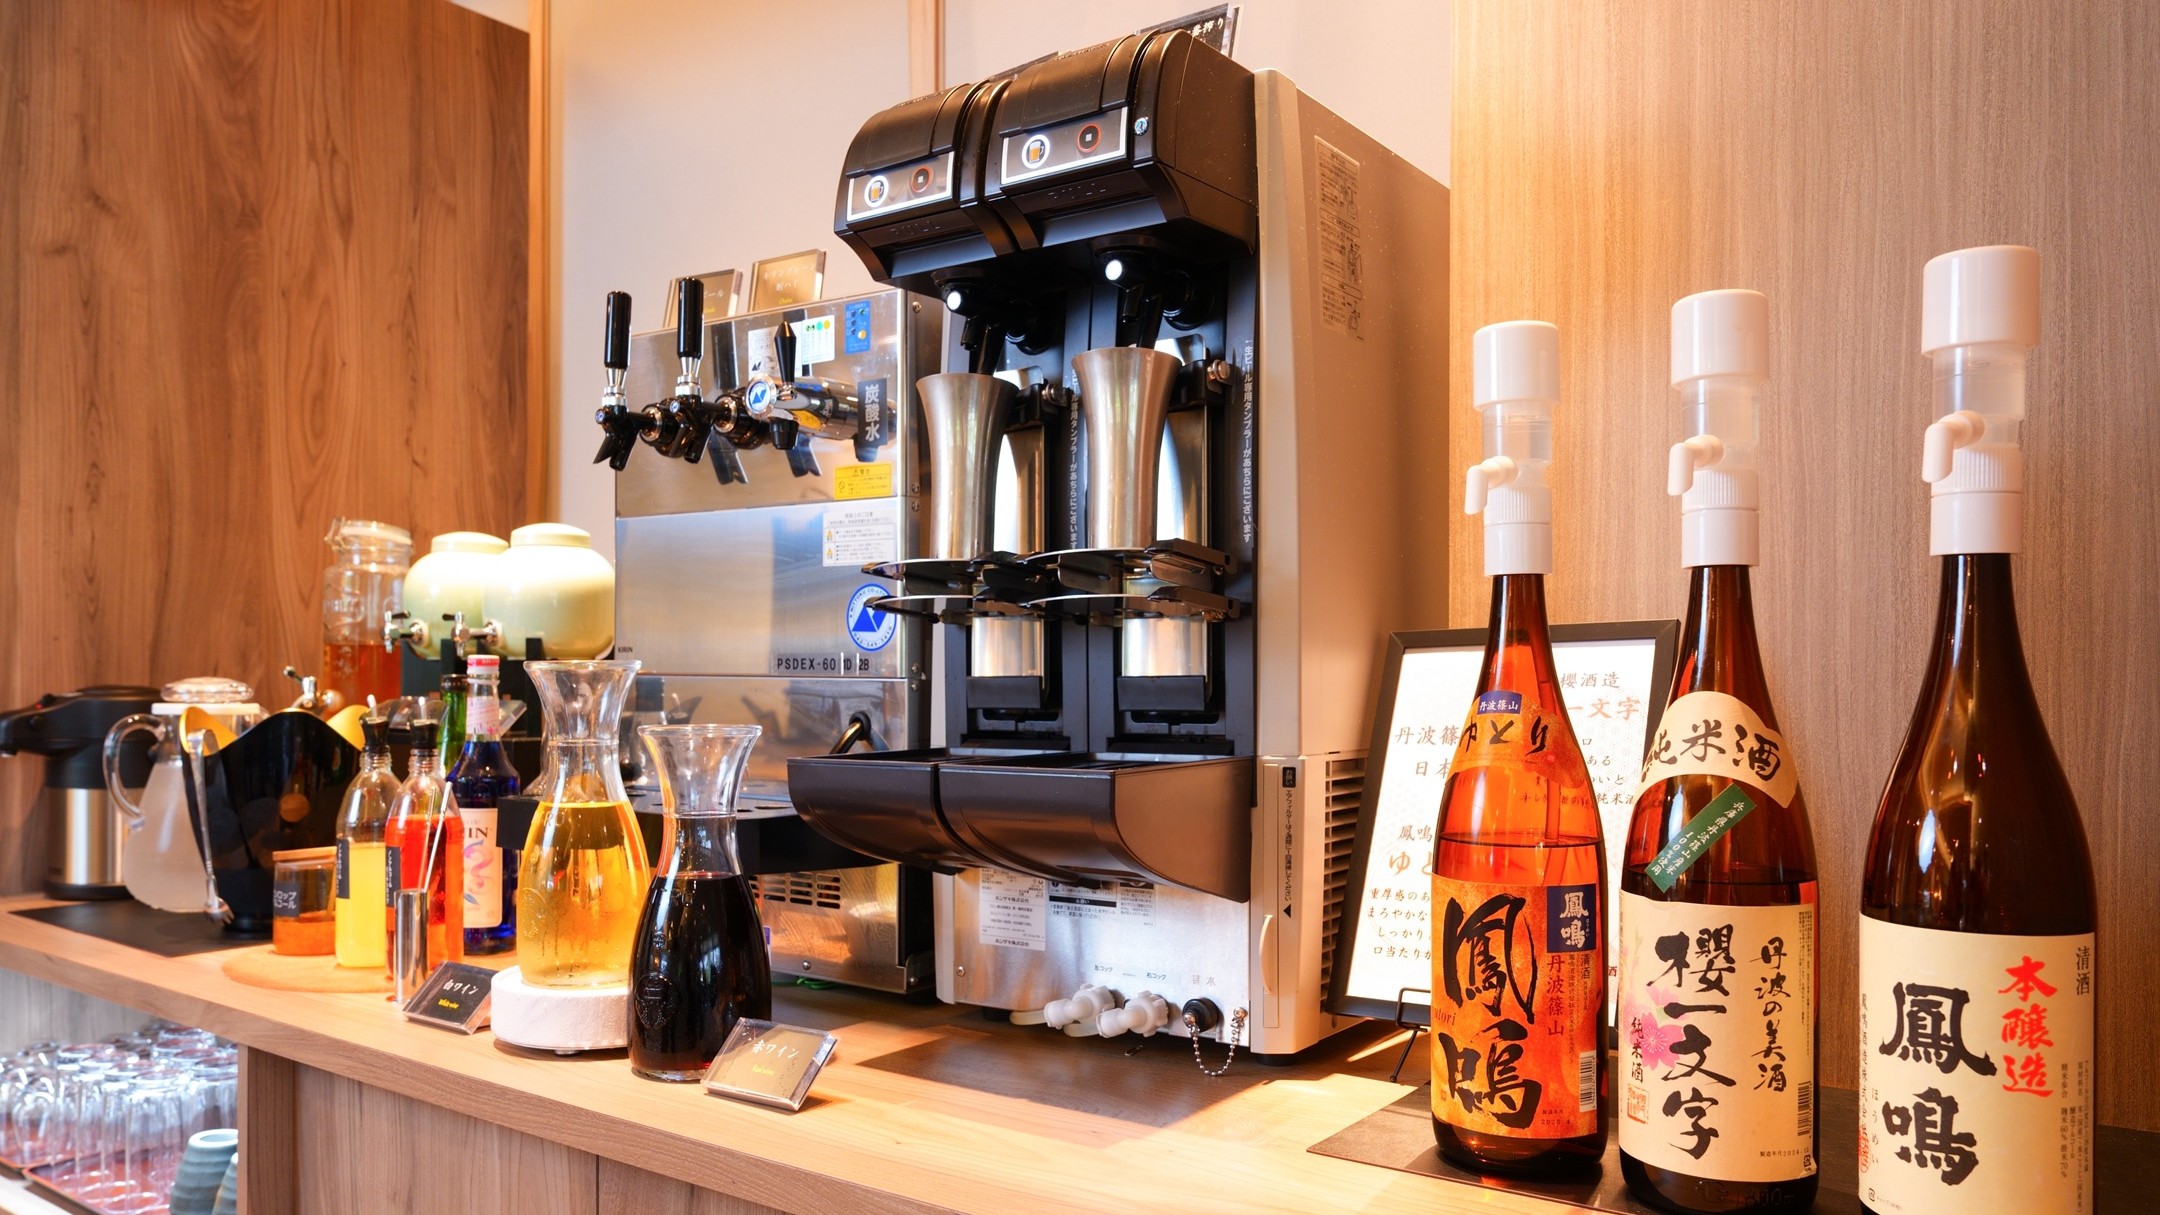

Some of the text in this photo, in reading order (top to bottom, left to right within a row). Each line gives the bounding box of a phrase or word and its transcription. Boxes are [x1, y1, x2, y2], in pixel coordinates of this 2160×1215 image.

[865, 384, 880, 441] 炭酸水
[777, 657, 836, 671] PSDEX-60
[859, 658, 869, 671] 2B
[1561, 671, 1620, 689] 櫻酒造
[1479, 700, 1518, 711] 丹波篠山
[1567, 697, 1641, 721] 一文字
[1395, 725, 1460, 746] 丹波篠
[1458, 716, 1549, 756] ゆとり
[1641, 719, 1781, 783] 純米酒
[1587, 756, 1611, 766] ある
[1398, 825, 1432, 842] 鳳鳴
[1666, 802, 1744, 875] 兵庫県丹波篠山産米
[1368, 907, 1427, 921] まろやかな
[1378, 926, 1431, 940] しっかり
[1559, 891, 1589, 948] 鳳鳴
[443, 979, 478, 994] 白ワイン
[1581, 954, 1590, 979] 清酒
[2076, 946, 2090, 996] 清酒
[1439, 893, 1542, 1129] 鳳鳴
[1547, 954, 1565, 1036] 丹波篠山
[1750, 936, 1791, 1092] 丹波の美酒
[1647, 924, 1736, 1159] 櫻一文字
[1998, 955, 2058, 1098] 本醸造
[752, 1039, 799, 1058] 赤ワイン
[1631, 1016, 1644, 1084] 純米酒
[1878, 981, 1997, 1187] 鳳鳴
